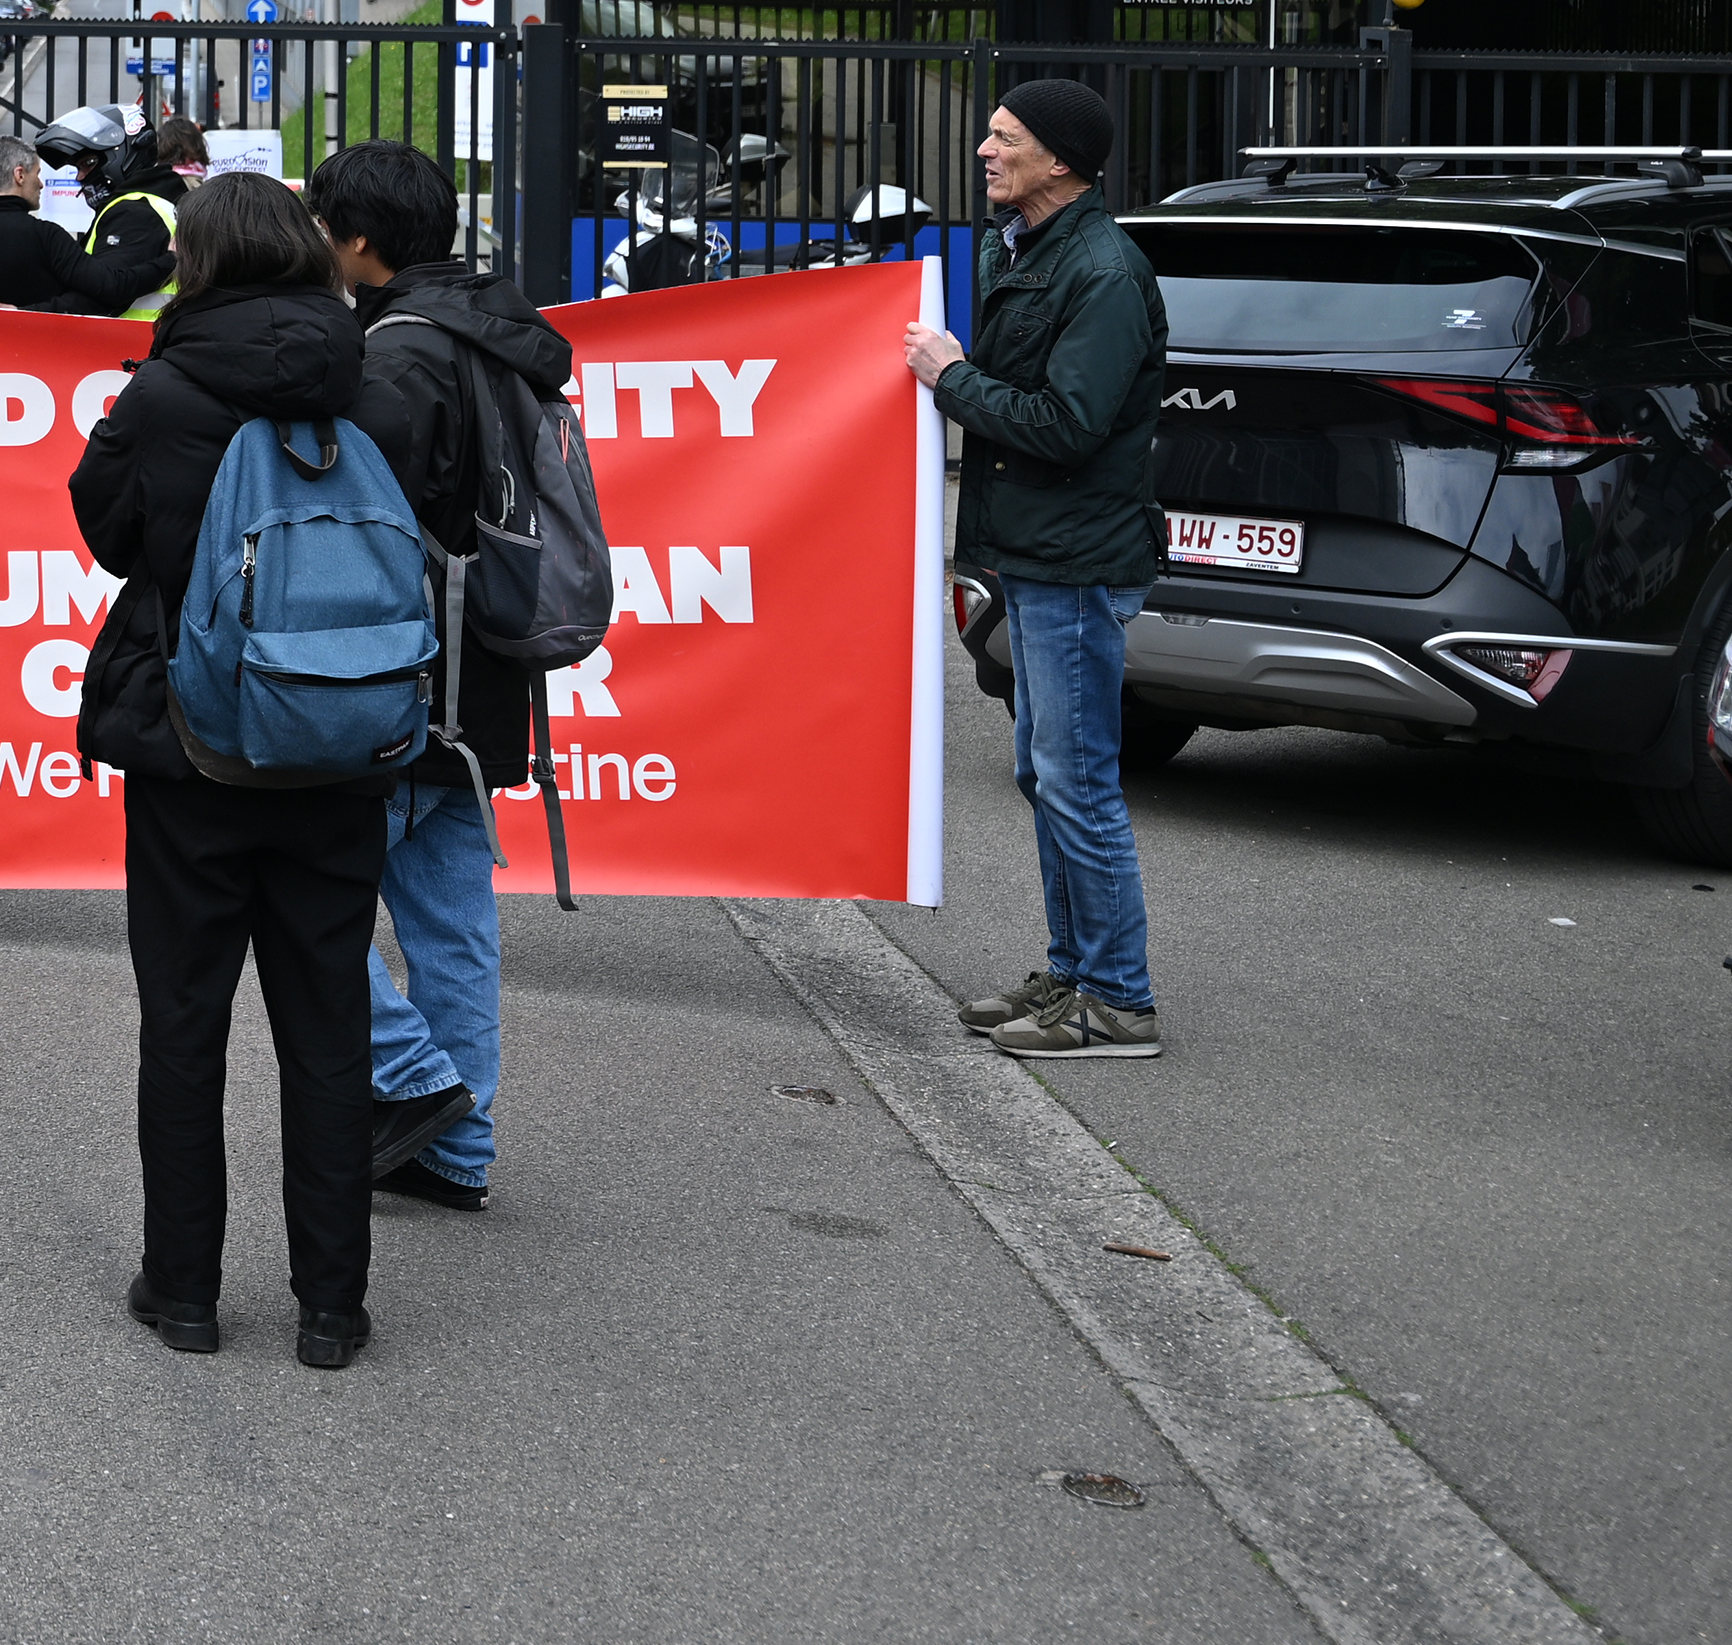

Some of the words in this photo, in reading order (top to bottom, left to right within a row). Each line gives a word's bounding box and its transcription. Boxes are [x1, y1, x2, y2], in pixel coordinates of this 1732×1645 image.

[254, 76, 267, 95] P
[621, 105, 663, 117] HIGH
[1245, 561, 1280, 571] ZAVENTEM
